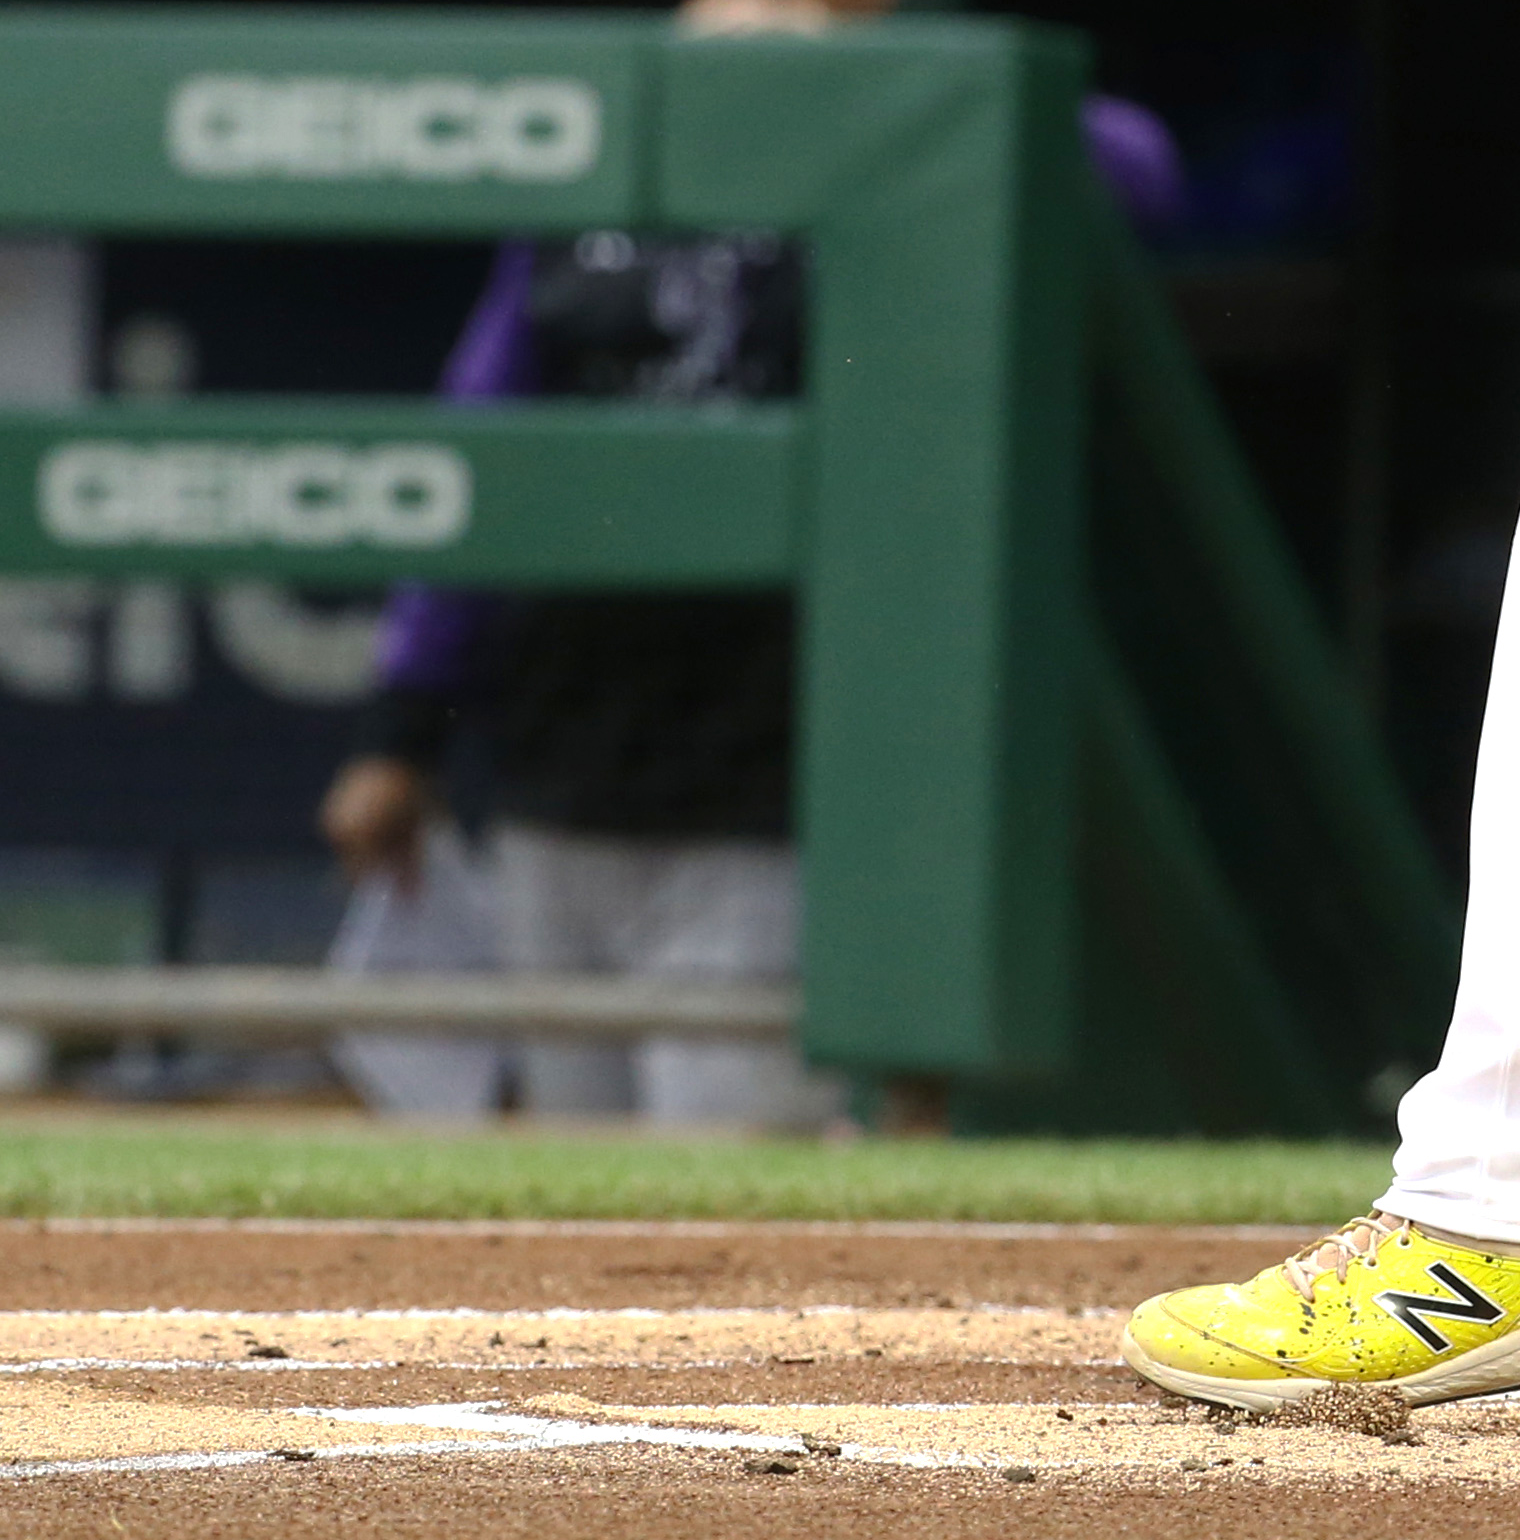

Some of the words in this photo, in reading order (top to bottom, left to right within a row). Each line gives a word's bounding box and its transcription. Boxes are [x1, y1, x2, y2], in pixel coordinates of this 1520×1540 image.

[168, 74, 600, 180] GEICO
[38, 440, 472, 546] GEICO
[1372, 1259, 1508, 1356] N
